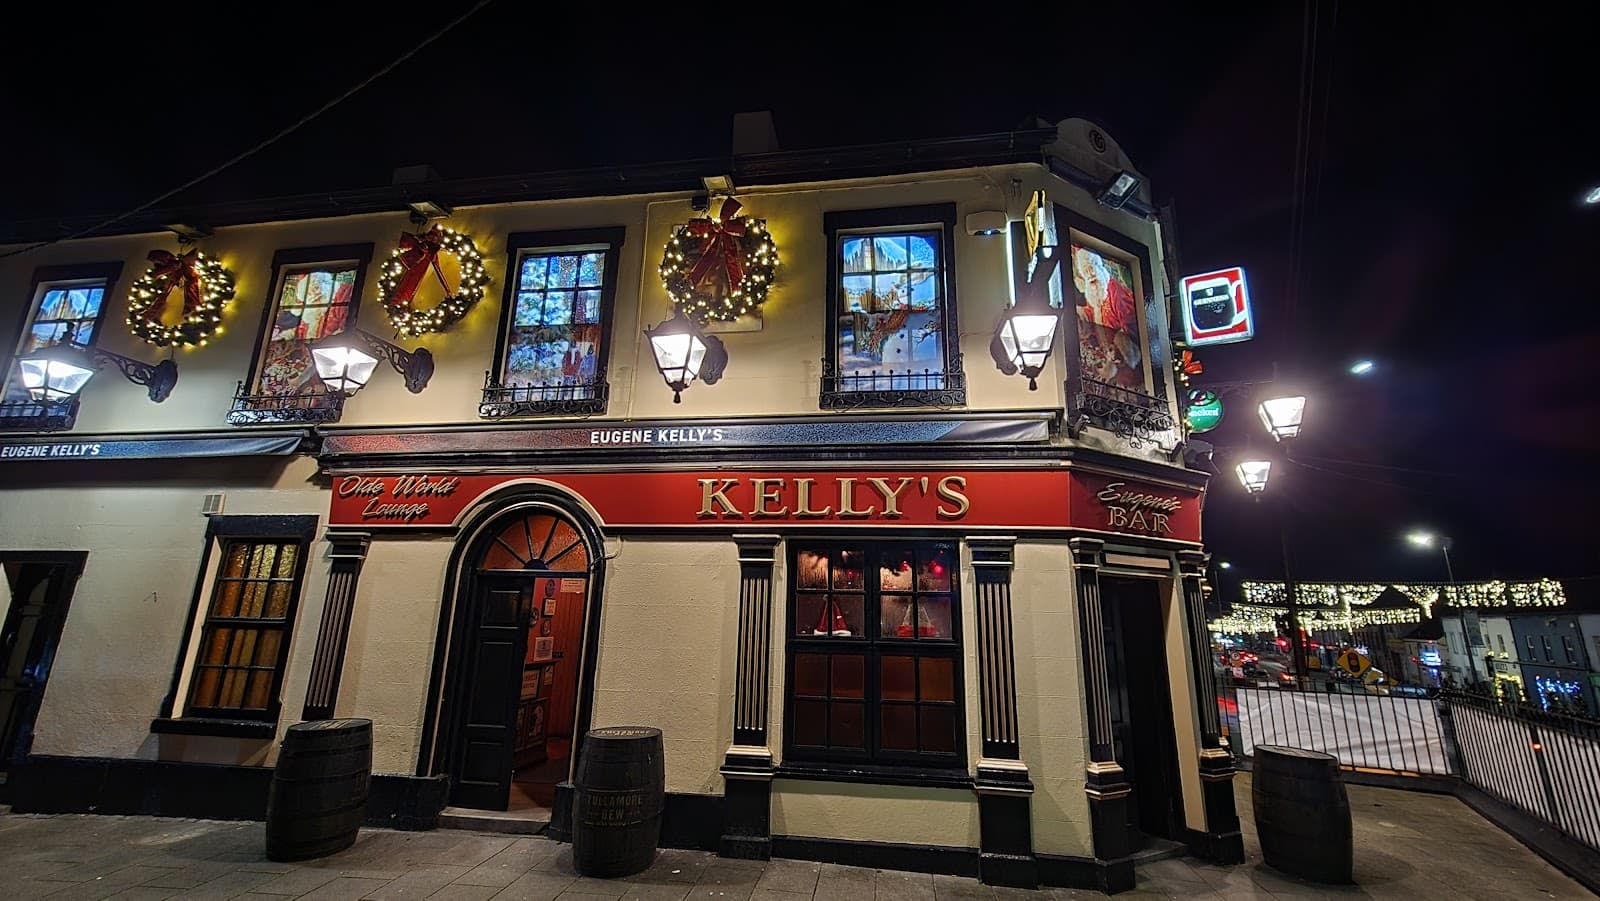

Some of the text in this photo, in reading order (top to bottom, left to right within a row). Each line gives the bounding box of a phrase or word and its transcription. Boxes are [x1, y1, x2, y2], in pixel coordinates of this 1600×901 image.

[590, 428, 723, 443] EUGENE KELLY'S
[1, 444, 101, 457] EUGENE KELLY'S
[338, 474, 459, 496] Olde World
[695, 475, 971, 518] KELLY'S
[1096, 482, 1183, 512] Eugene's
[361, 497, 429, 521] Lounge
[1107, 505, 1174, 533] BAR
